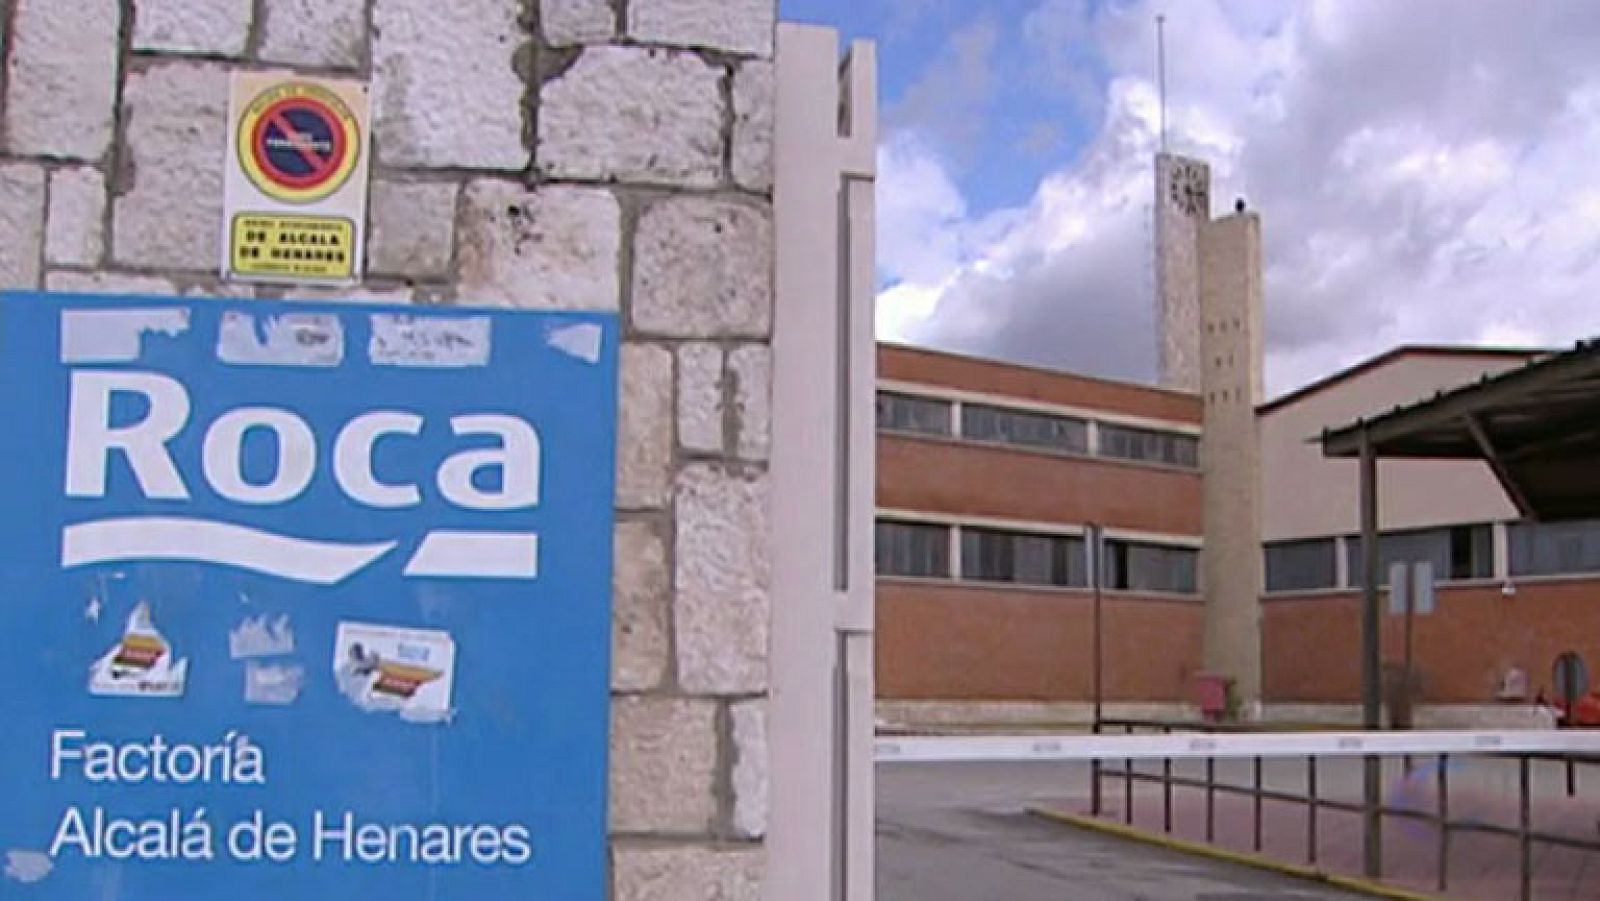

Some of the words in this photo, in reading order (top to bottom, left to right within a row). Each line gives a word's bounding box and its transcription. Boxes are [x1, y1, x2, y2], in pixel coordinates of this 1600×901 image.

[64, 368, 541, 509] Roca
[50, 729, 265, 782] Factoría
[50, 807, 213, 859] Alcalá
[227, 810, 297, 860] de
[313, 810, 531, 863] Henares
